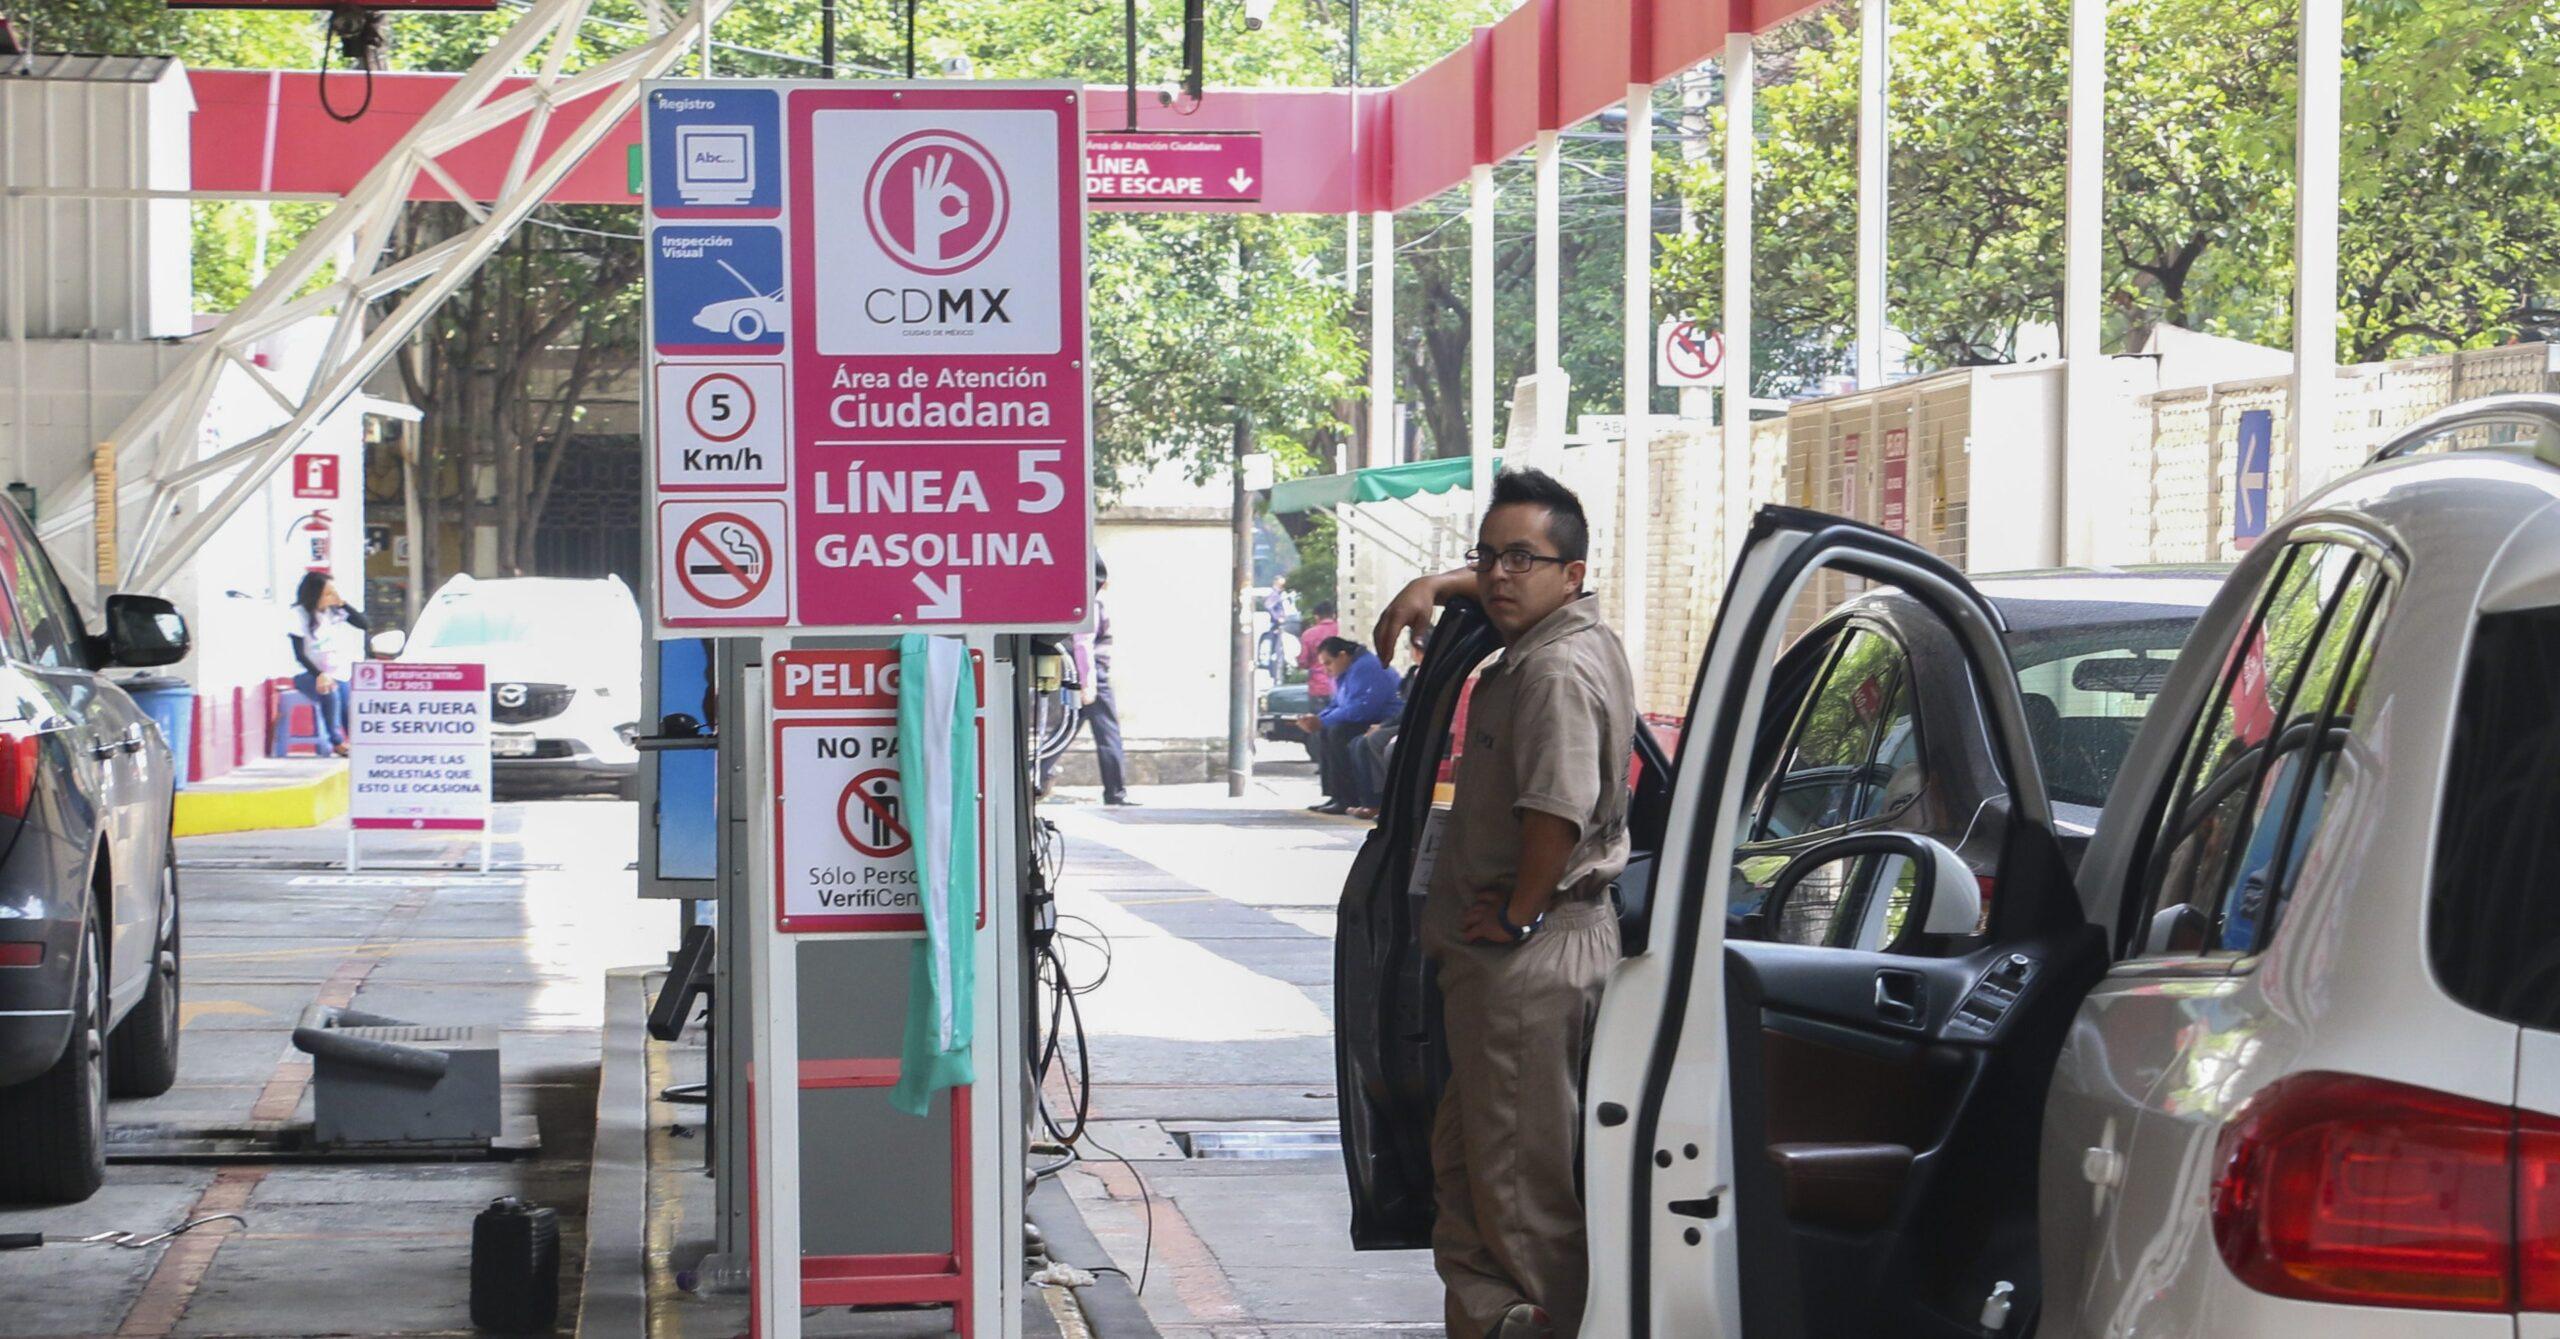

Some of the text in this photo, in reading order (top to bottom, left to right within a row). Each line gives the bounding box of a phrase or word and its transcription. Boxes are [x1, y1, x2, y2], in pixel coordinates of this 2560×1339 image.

[659, 99, 715, 112] Registro
[1086, 154, 1150, 175] LÍNEA
[1086, 177, 1203, 194] DE ESCAPE
[662, 236, 733, 249] Inspección
[662, 247, 704, 258] Visual
[865, 288, 1011, 324] CDMX
[832, 363, 1047, 388] Área de Atención
[711, 394, 730, 421] 5
[829, 394, 1050, 428] Ciudadana
[683, 449, 762, 473] Km/h
[814, 449, 1064, 514] LÍNEA 5
[814, 533, 1054, 568] GASOLINA
[785, 664, 899, 696] PELIG
[358, 699, 477, 714] LÍNEA FUERA
[361, 721, 475, 734] DE SERVICIO
[817, 738, 899, 758] NO PA
[375, 755, 465, 764] DISCULPE LAS
[368, 770, 471, 779] MOLESTIAS QUE
[358, 783, 481, 793] ESTO LE OCASIONA
[809, 867, 918, 885] Sólo Perso
[818, 887, 919, 907] VerifiCen
